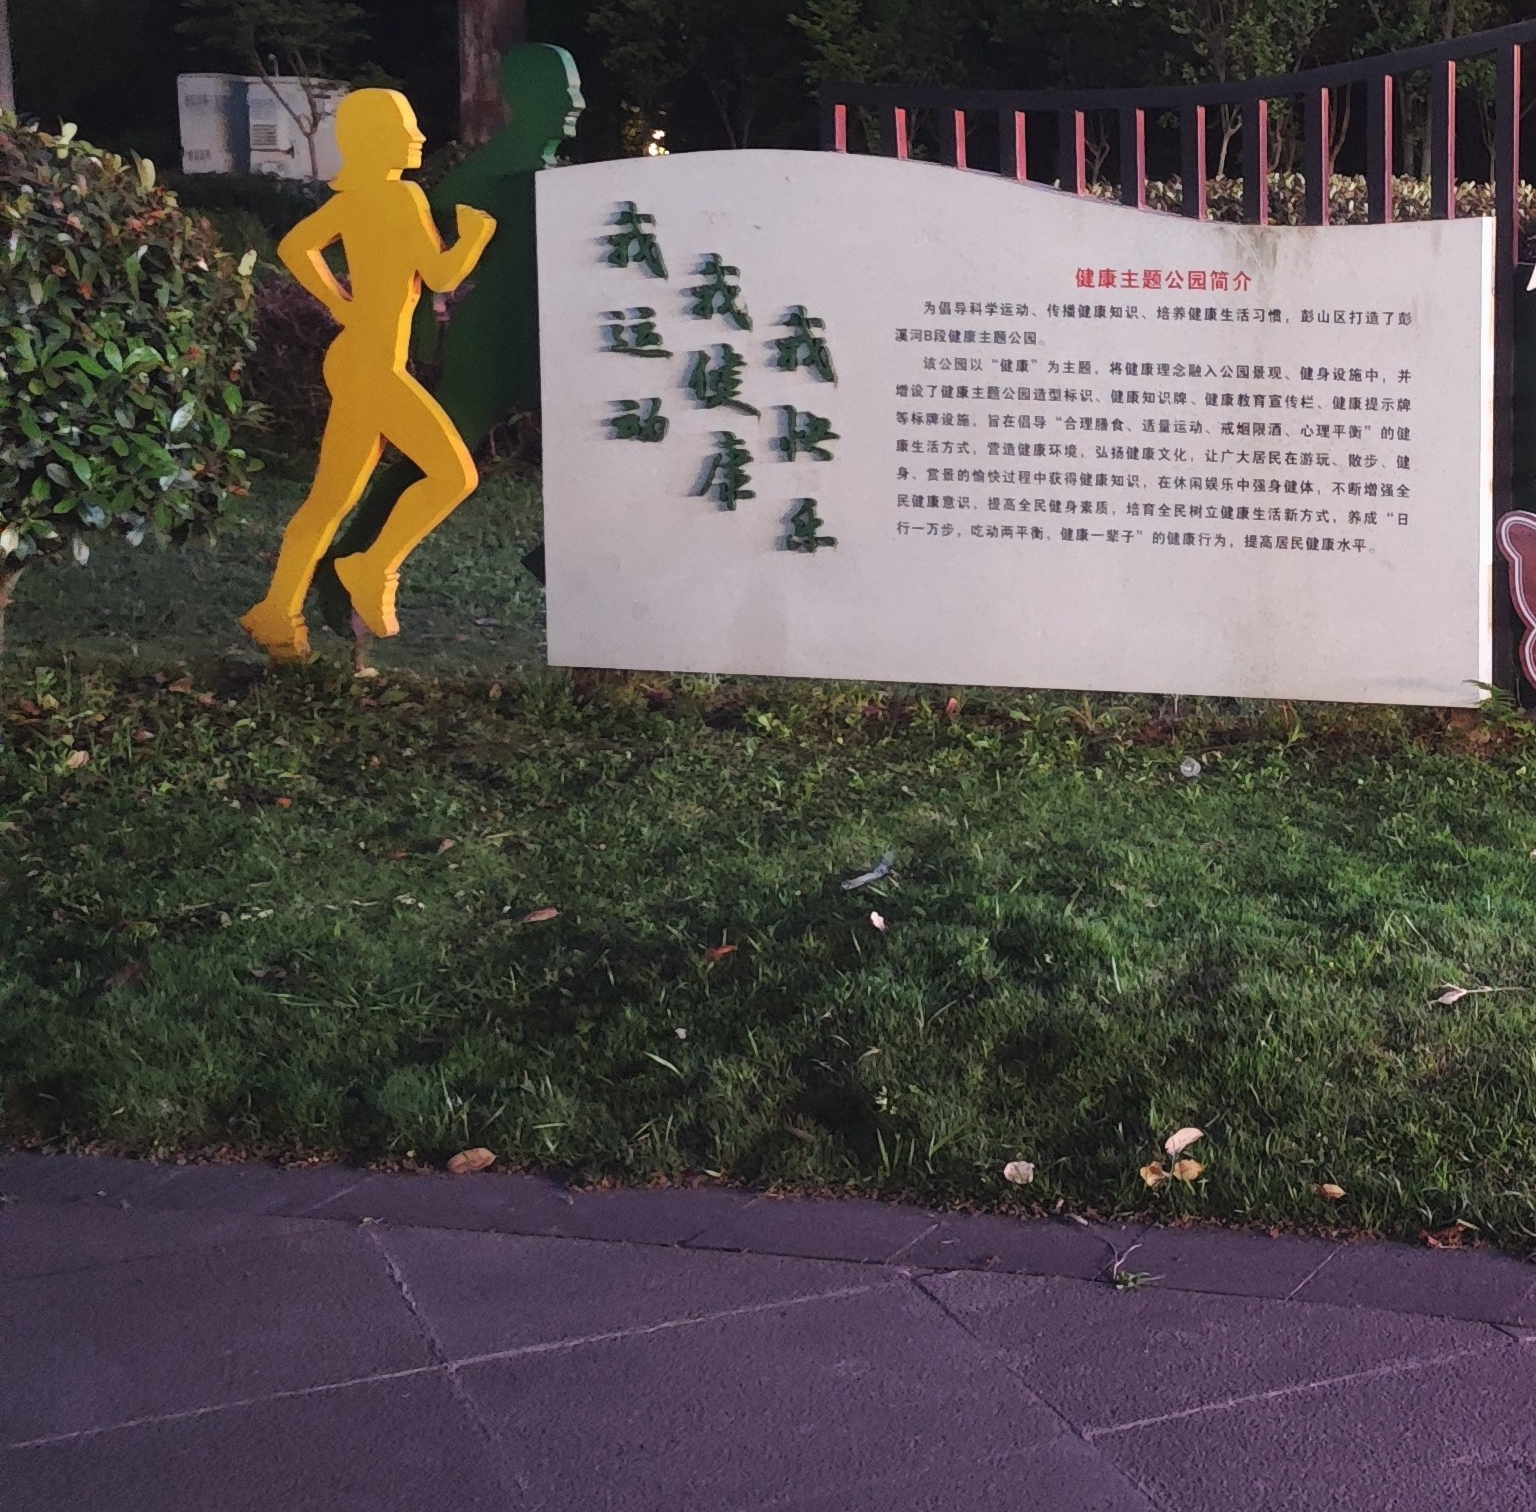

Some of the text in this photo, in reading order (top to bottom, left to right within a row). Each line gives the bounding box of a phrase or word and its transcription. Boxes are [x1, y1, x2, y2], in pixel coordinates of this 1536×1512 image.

[601, 200, 673, 443] 我运动
[684, 252, 761, 512] 我健康
[1075, 267, 1252, 292] 健康主题公园简介
